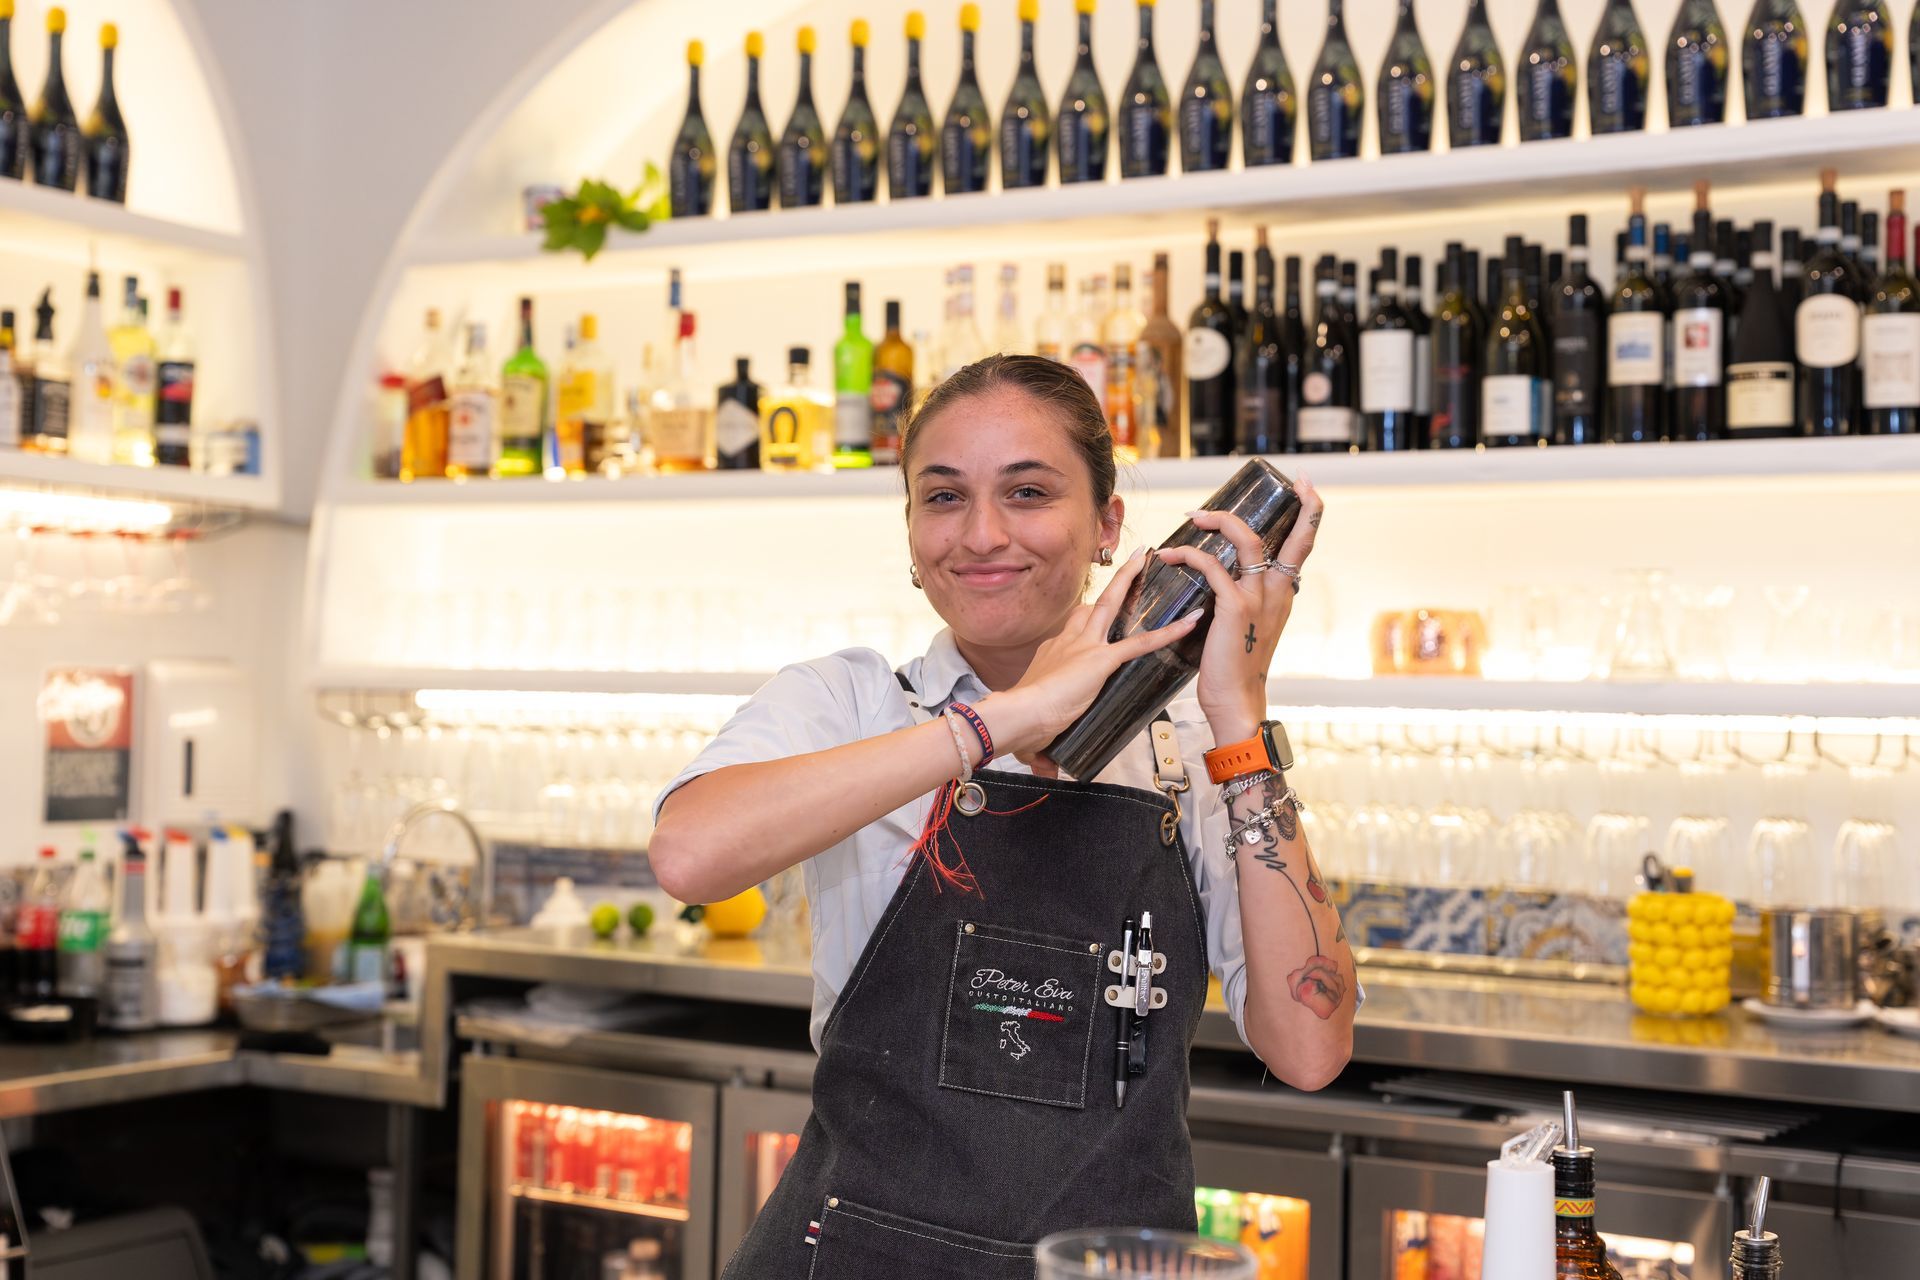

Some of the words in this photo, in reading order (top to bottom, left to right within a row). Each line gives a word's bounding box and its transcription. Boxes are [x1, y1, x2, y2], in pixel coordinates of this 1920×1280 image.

[973, 719, 993, 753] COAST
[970, 968, 1031, 993] Peter
[1034, 978, 1075, 1000] Eva
